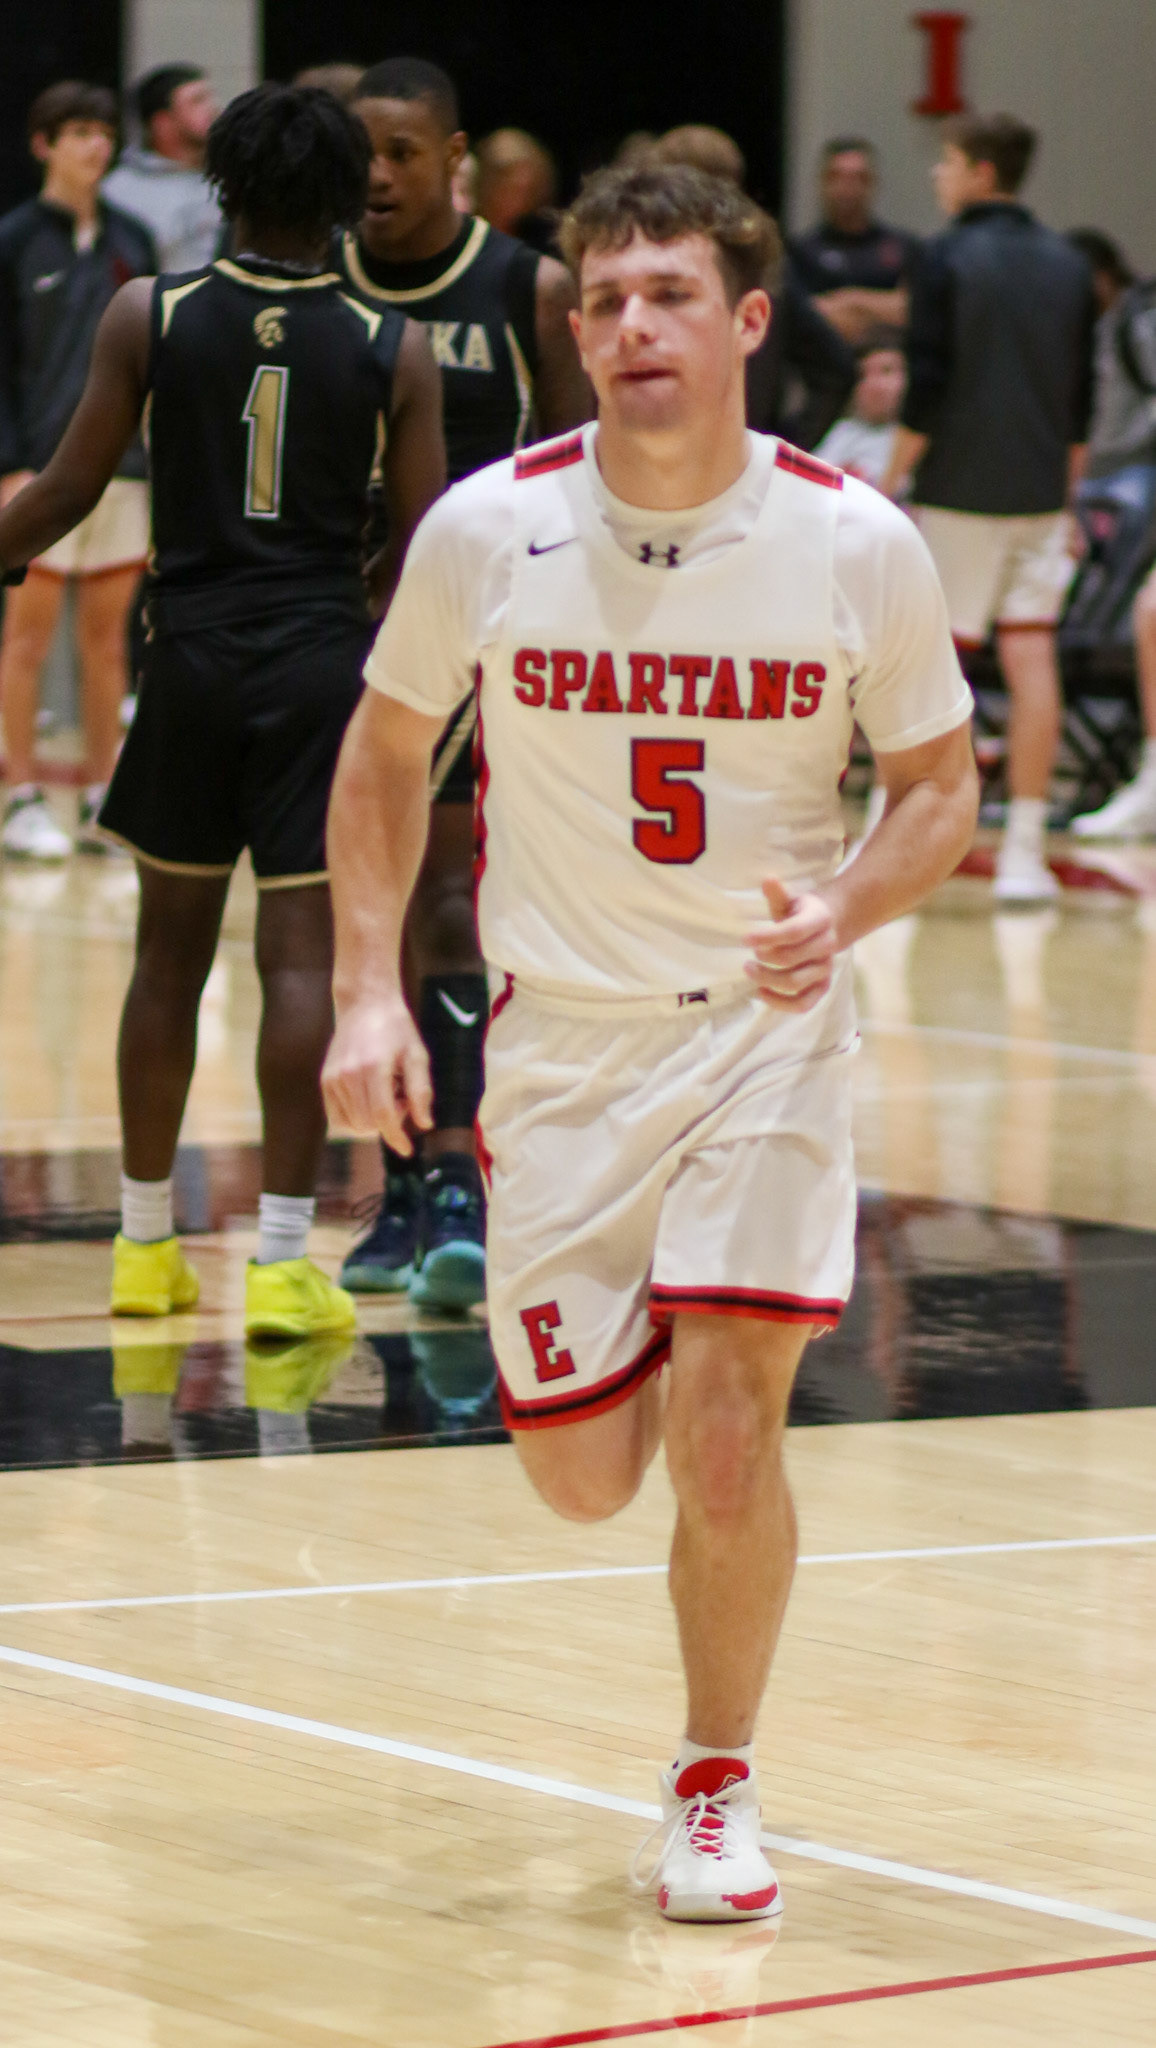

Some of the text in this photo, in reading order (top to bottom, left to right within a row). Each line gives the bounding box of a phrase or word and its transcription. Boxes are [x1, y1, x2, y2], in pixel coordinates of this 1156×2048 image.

[911, 10, 968, 115] I
[241, 364, 290, 519] 1
[513, 647, 827, 720] SPARTANS
[630, 737, 706, 865] 5
[519, 1299, 577, 1384] E
